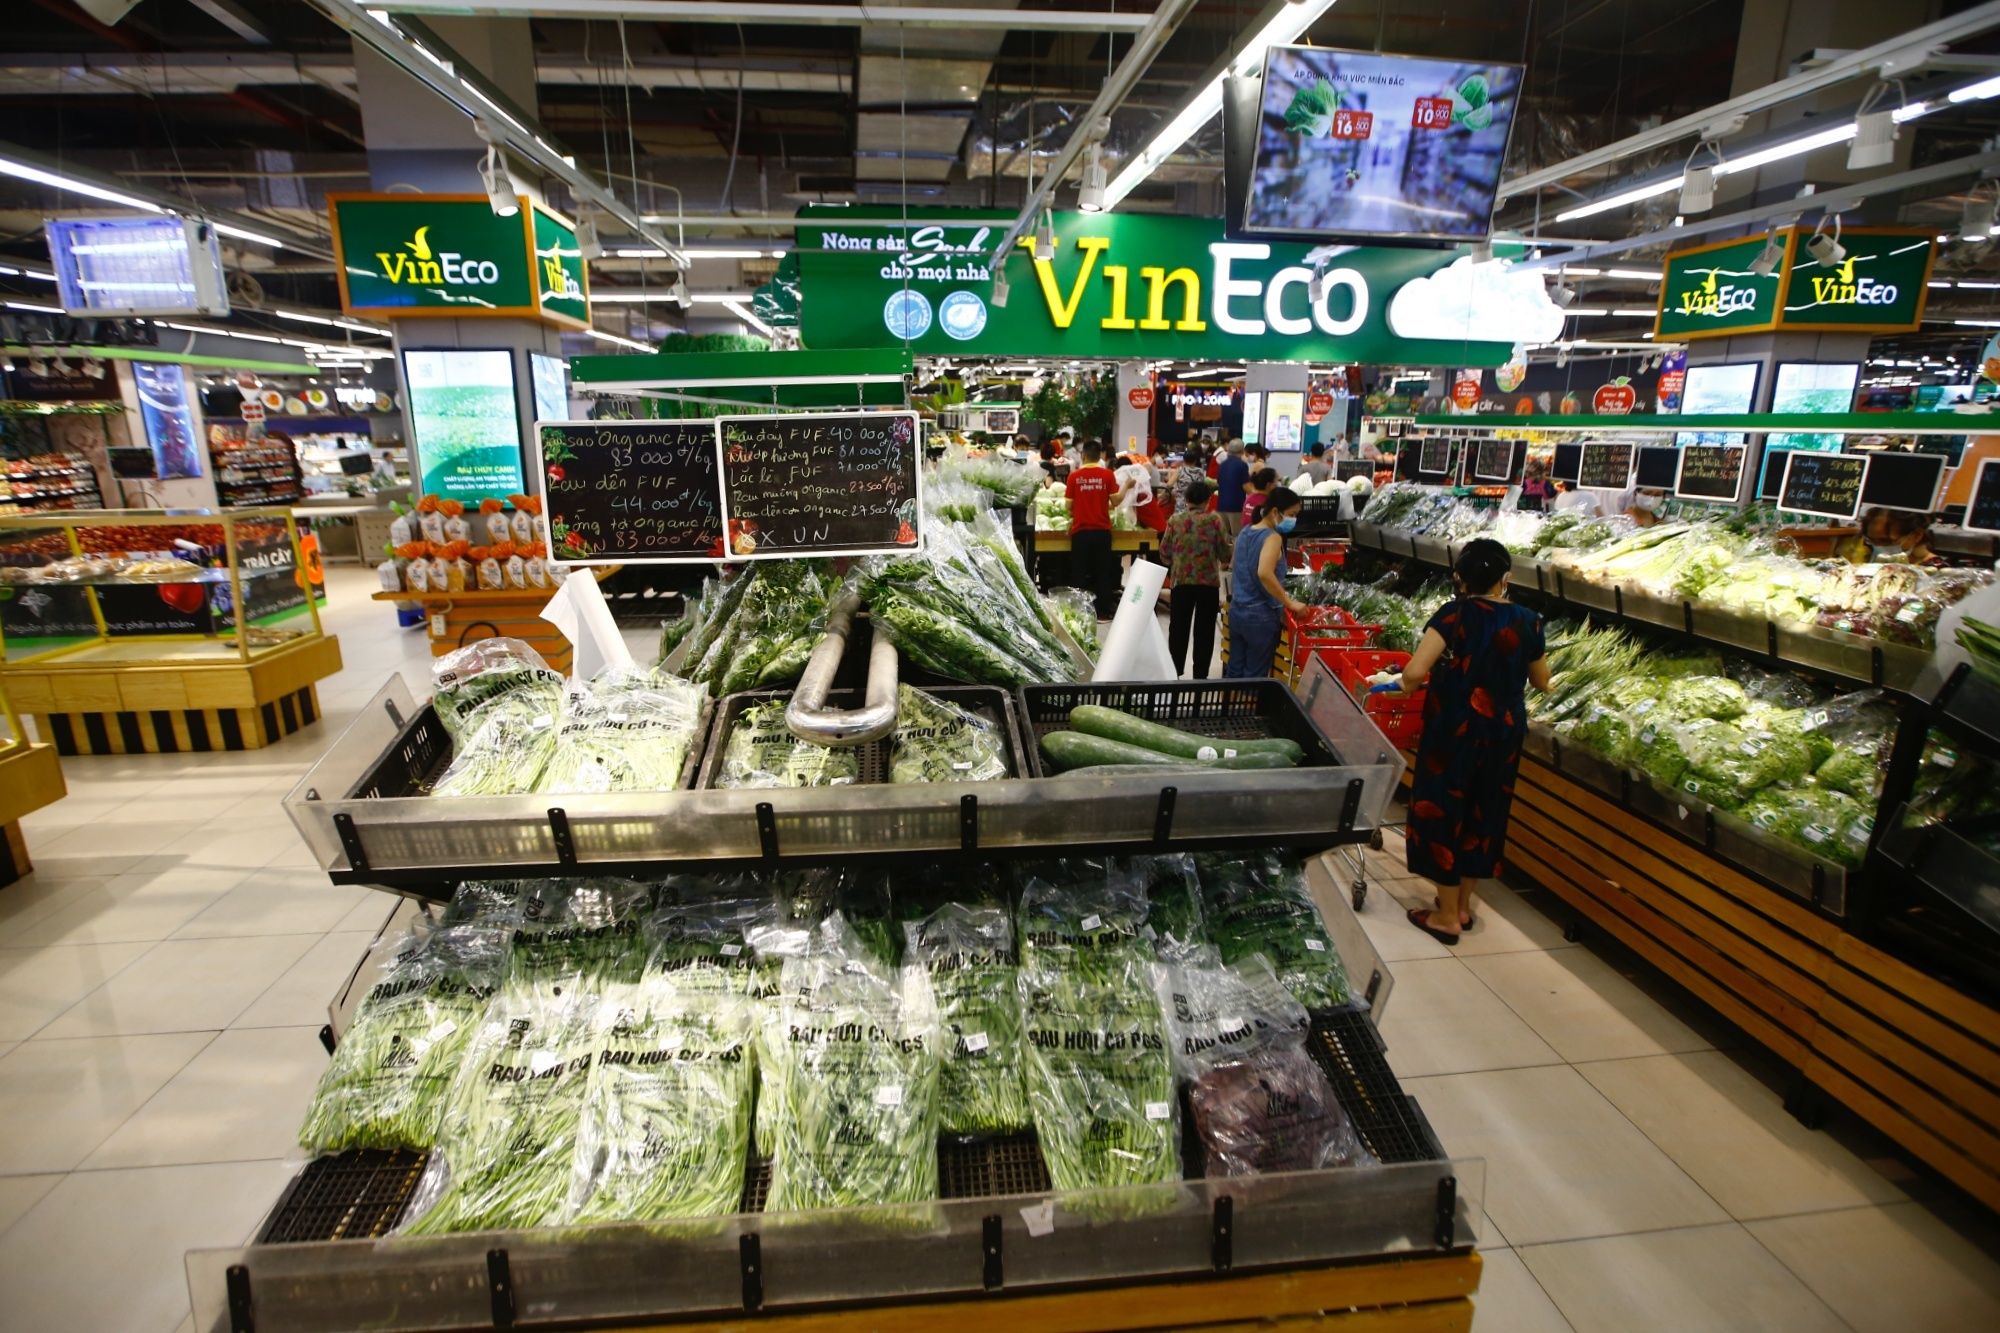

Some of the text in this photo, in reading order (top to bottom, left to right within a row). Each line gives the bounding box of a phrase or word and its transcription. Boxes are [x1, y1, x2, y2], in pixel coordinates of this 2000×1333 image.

[1331, 74, 1347, 82] KHU
[376, 252, 499, 285] VinEco
[880, 261, 990, 283] cho mọi nhà
[1682, 284, 1758, 316] VinEco
[1811, 277, 1899, 305] VinEco
[598, 431, 673, 453] Organic
[812, 448, 834, 457] FUF
[637, 475, 677, 489] FUF
[614, 919, 637, 936] GS
[372, 981, 402, 1001] RAU
[1130, 1031, 1163, 1050] PGS
[598, 1050, 635, 1066] RAU
[488, 1063, 527, 1083] RAU
